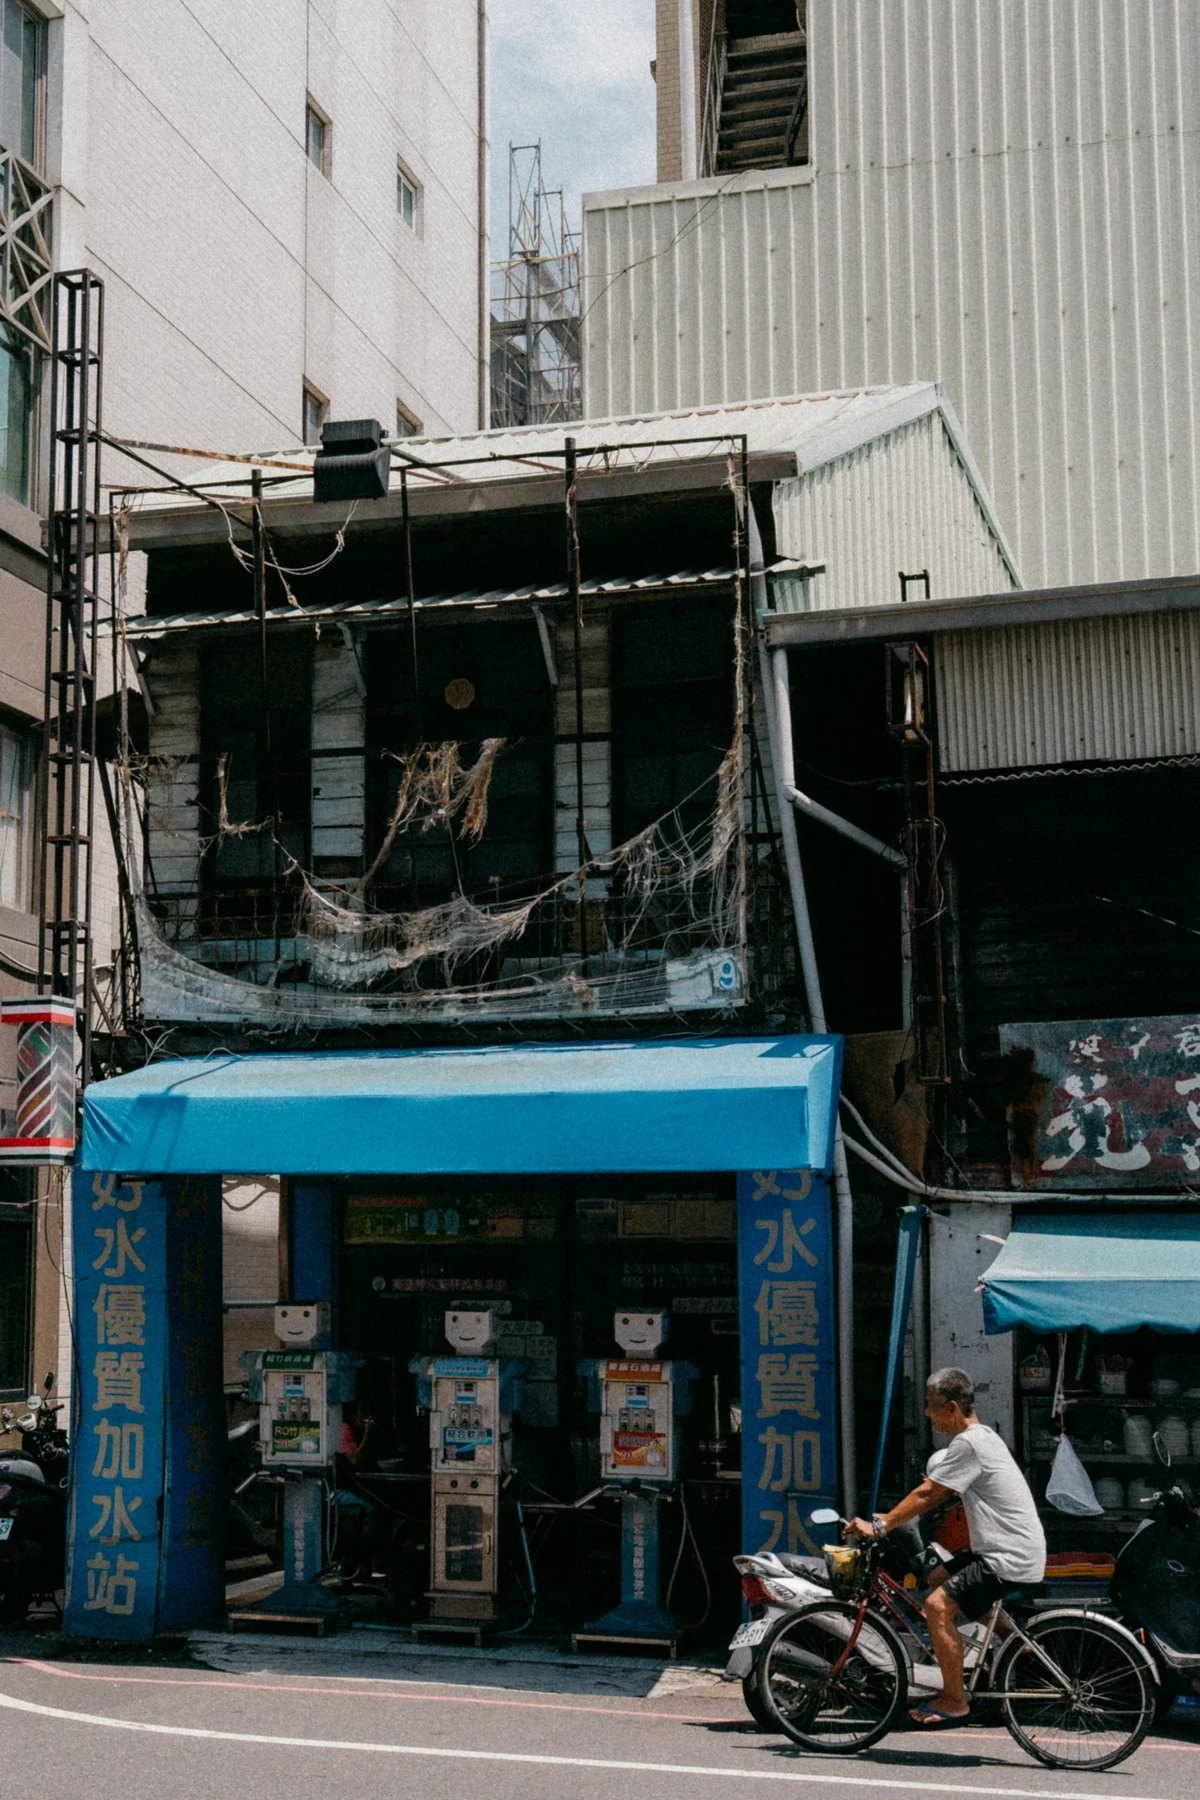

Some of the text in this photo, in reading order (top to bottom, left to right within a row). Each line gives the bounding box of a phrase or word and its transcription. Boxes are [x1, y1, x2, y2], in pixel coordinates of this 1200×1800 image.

[83, 1173, 147, 1616] 好水優質加水站
